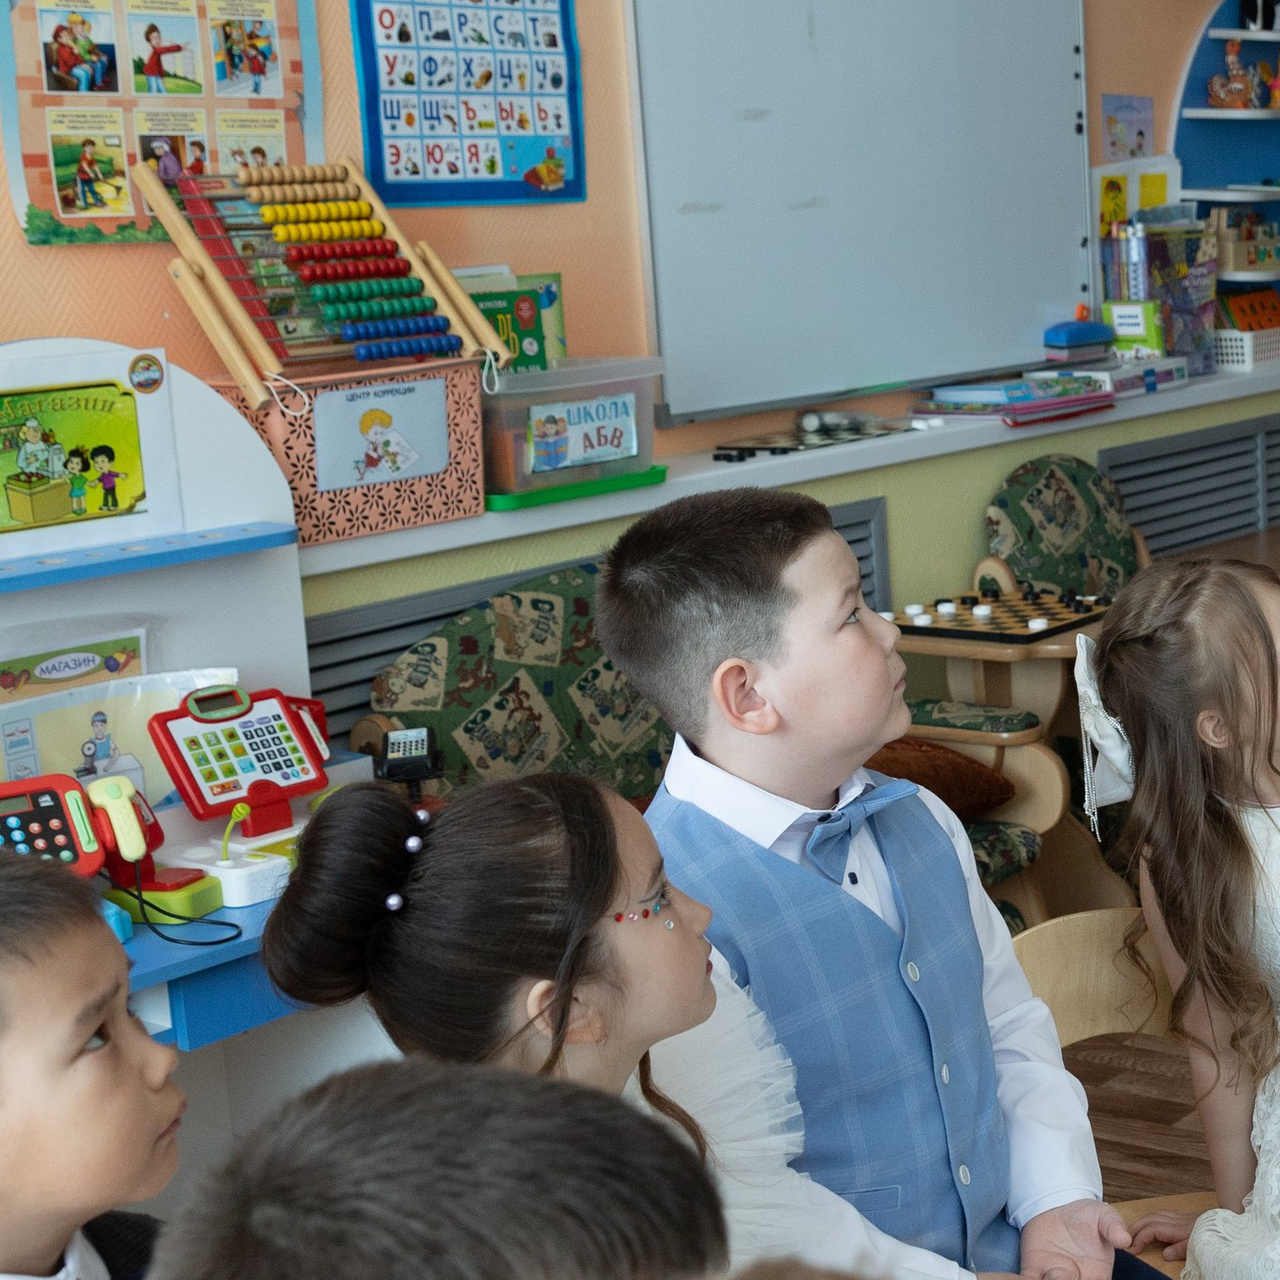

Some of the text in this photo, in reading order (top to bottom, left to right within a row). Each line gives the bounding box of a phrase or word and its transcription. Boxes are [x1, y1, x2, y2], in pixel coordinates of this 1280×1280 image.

[378, 8, 539, 37] О П Р С Т
[384, 55, 547, 82] У Ф Х Ц Ч
[383, 100, 548, 126] Ш Щ Ъ Ы Ь
[388, 144, 480, 165] Э Ю Я
[566, 401, 630, 426] ШКОЛА
[582, 426, 624, 453] АБВ
[39, 655, 96, 676] МАГАЗИН
